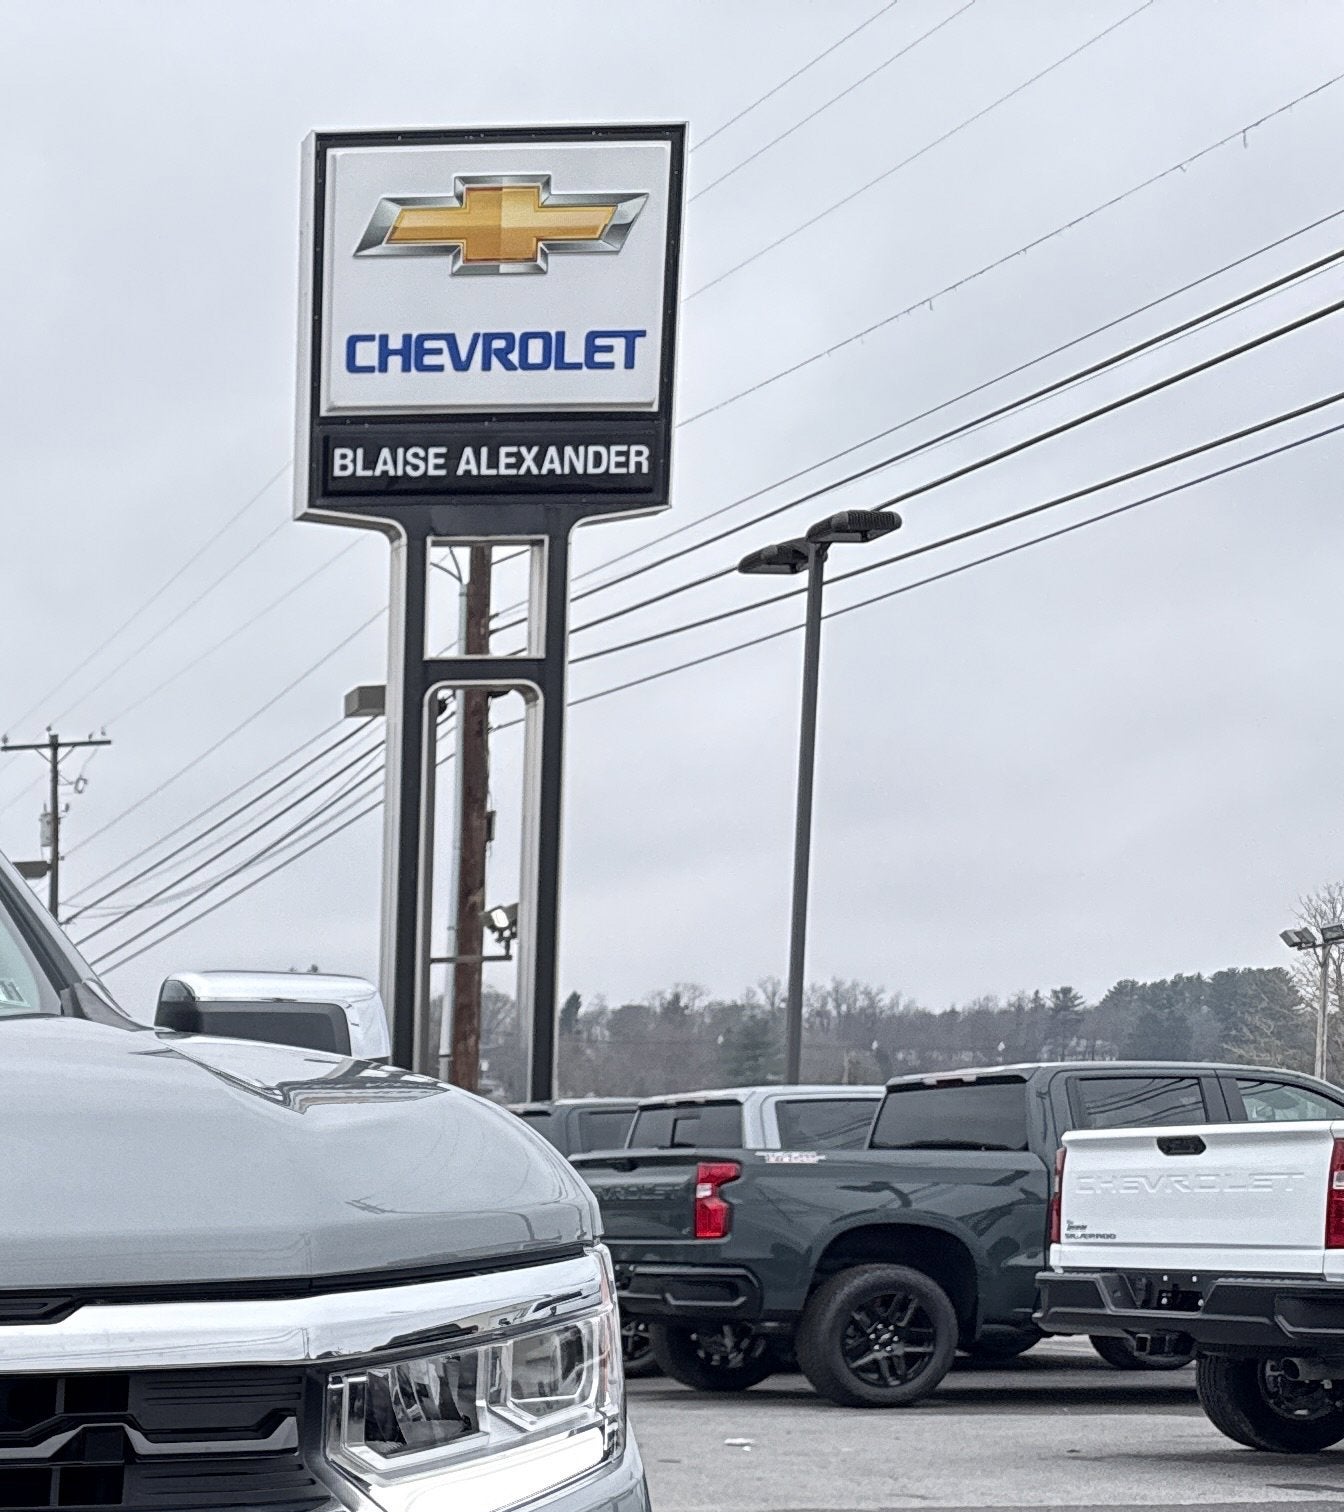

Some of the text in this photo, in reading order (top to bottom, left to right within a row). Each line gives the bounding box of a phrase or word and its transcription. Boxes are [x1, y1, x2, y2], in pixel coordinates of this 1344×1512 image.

[346, 329, 647, 373] CHEVROLET
[332, 444, 650, 478] BLAISE ALEXANDER
[1075, 1171, 1305, 1195] CHEVROLET
